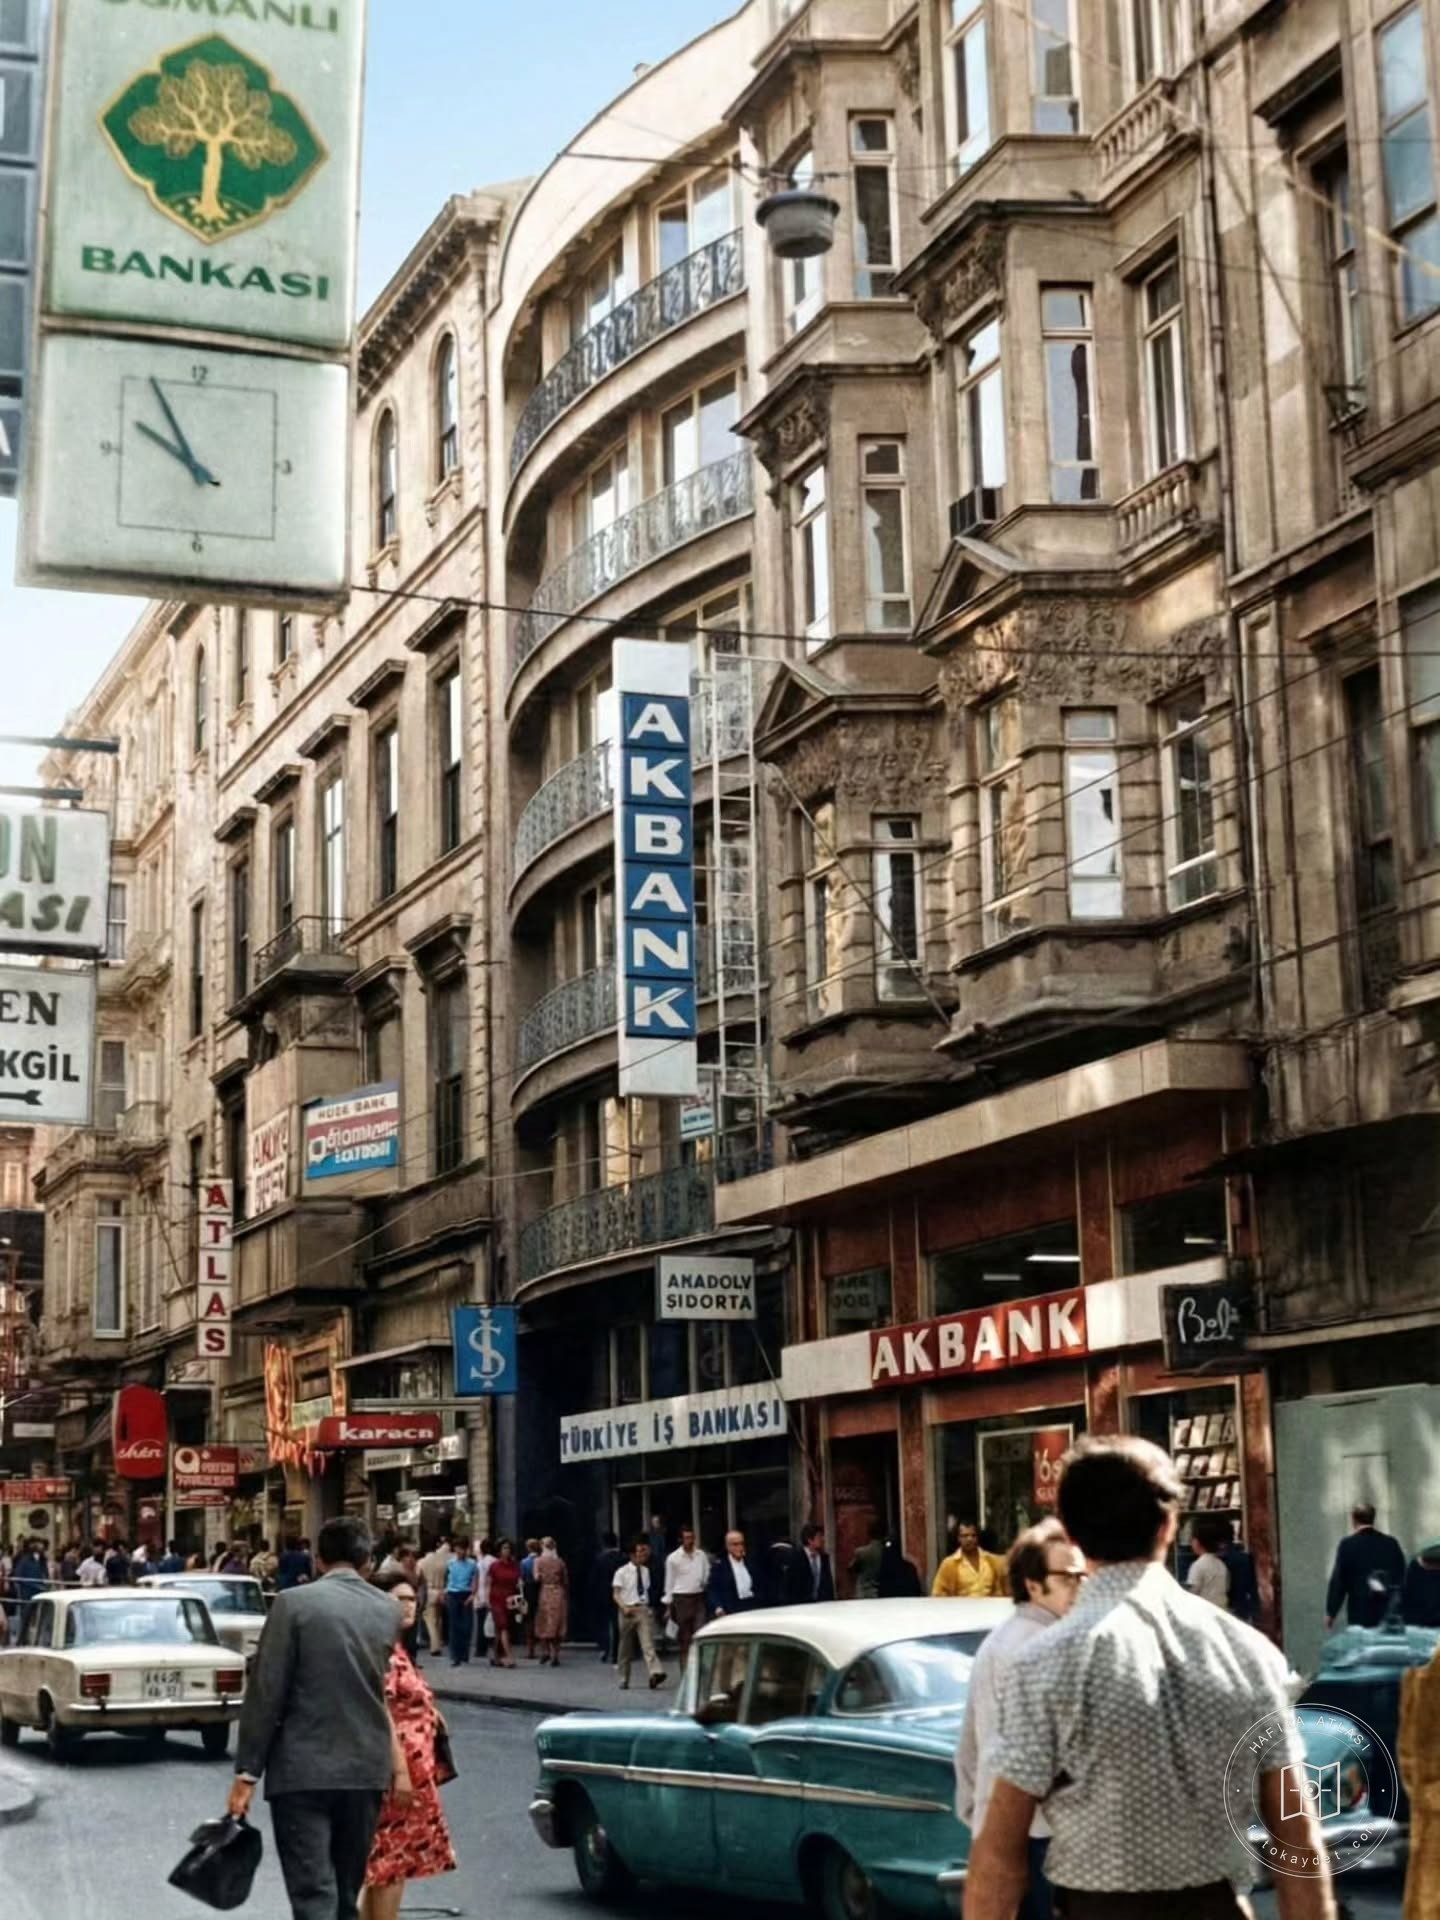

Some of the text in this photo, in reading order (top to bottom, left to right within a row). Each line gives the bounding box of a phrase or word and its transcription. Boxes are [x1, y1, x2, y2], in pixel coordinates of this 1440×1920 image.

[102, 0, 338, 32] MANLI
[81, 245, 329, 300] BANKASI
[191, 365, 209, 380] 12
[281, 459, 292, 474] 3
[628, 703, 690, 1030] AKBANK
[205, 1184, 228, 1352] ATLAS
[872, 1297, 1083, 1380] AKBANK
[560, 1399, 780, 1455] TÜRKİYE İŞ BANKASI
